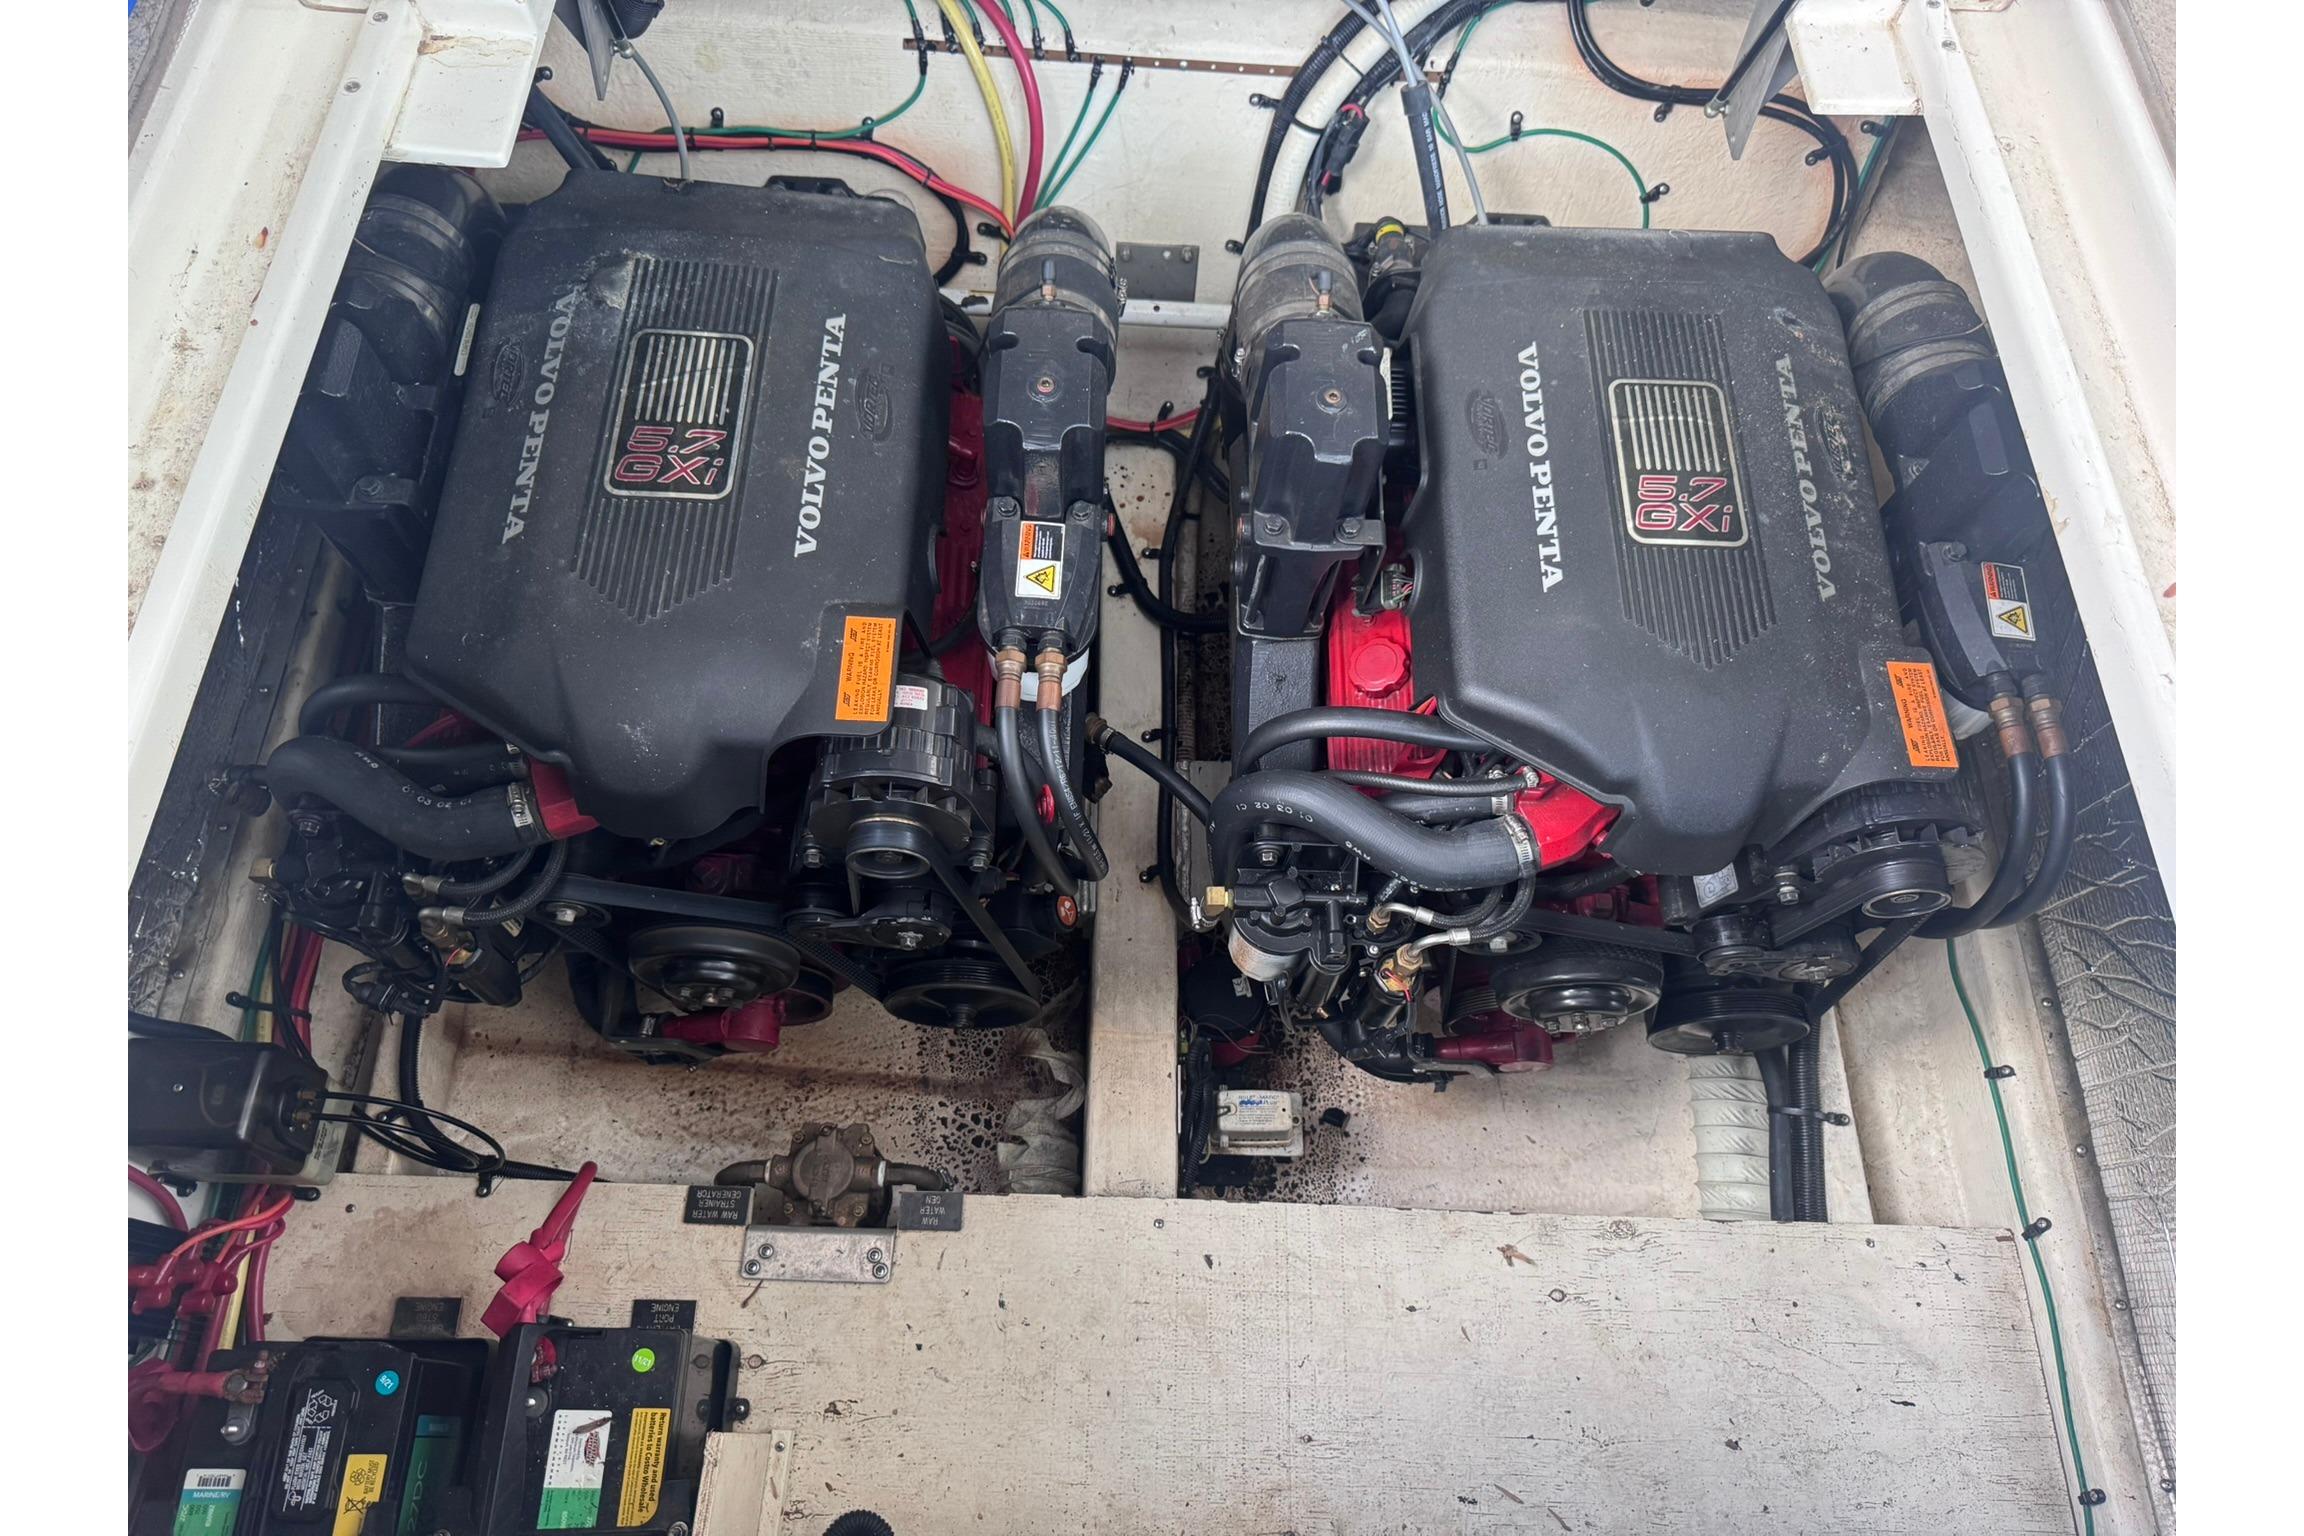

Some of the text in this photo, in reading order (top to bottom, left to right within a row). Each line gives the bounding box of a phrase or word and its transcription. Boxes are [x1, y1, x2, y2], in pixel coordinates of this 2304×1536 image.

[502, 285, 578, 544] VOLVO PENTA
[1775, 354, 1812, 467] PENTA
[627, 426, 728, 455] 5.7
[794, 314, 846, 557] VOLVO PENTA
[615, 455, 724, 486] GXi
[1517, 342, 1564, 592] VOLVO PENTA
[1637, 474, 1728, 502] 5.7
[1636, 503, 1733, 534] GXi
[1798, 480, 1837, 602] VOLVO
[846, 652, 854, 682] WARNING
[1902, 699, 1913, 729] WARNING
[417, 796, 432, 806] 03
[1254, 799, 1270, 811] 02
[1276, 802, 1293, 816] 03
[697, 1189, 741, 1198] GENERATOR
[698, 1199, 735, 1207] STRAINER
[926, 1195, 941, 1204] GEN
[692, 1210, 738, 1219] RAW WATER
[920, 1206, 945, 1215] WATER
[921, 1217, 938, 1225] RAW
[650, 1303, 679, 1312] ENGINE
[653, 1313, 674, 1323] PORT
[647, 1412, 657, 1442] batteries
[657, 1412, 667, 1435] Return
[643, 1452, 652, 1474] Costco
[652, 1437, 662, 1468] warranty
[407, 1457, 428, 1532] 27DC
[638, 1476, 649, 1513] Wholesale
[648, 1484, 656, 1502] used
